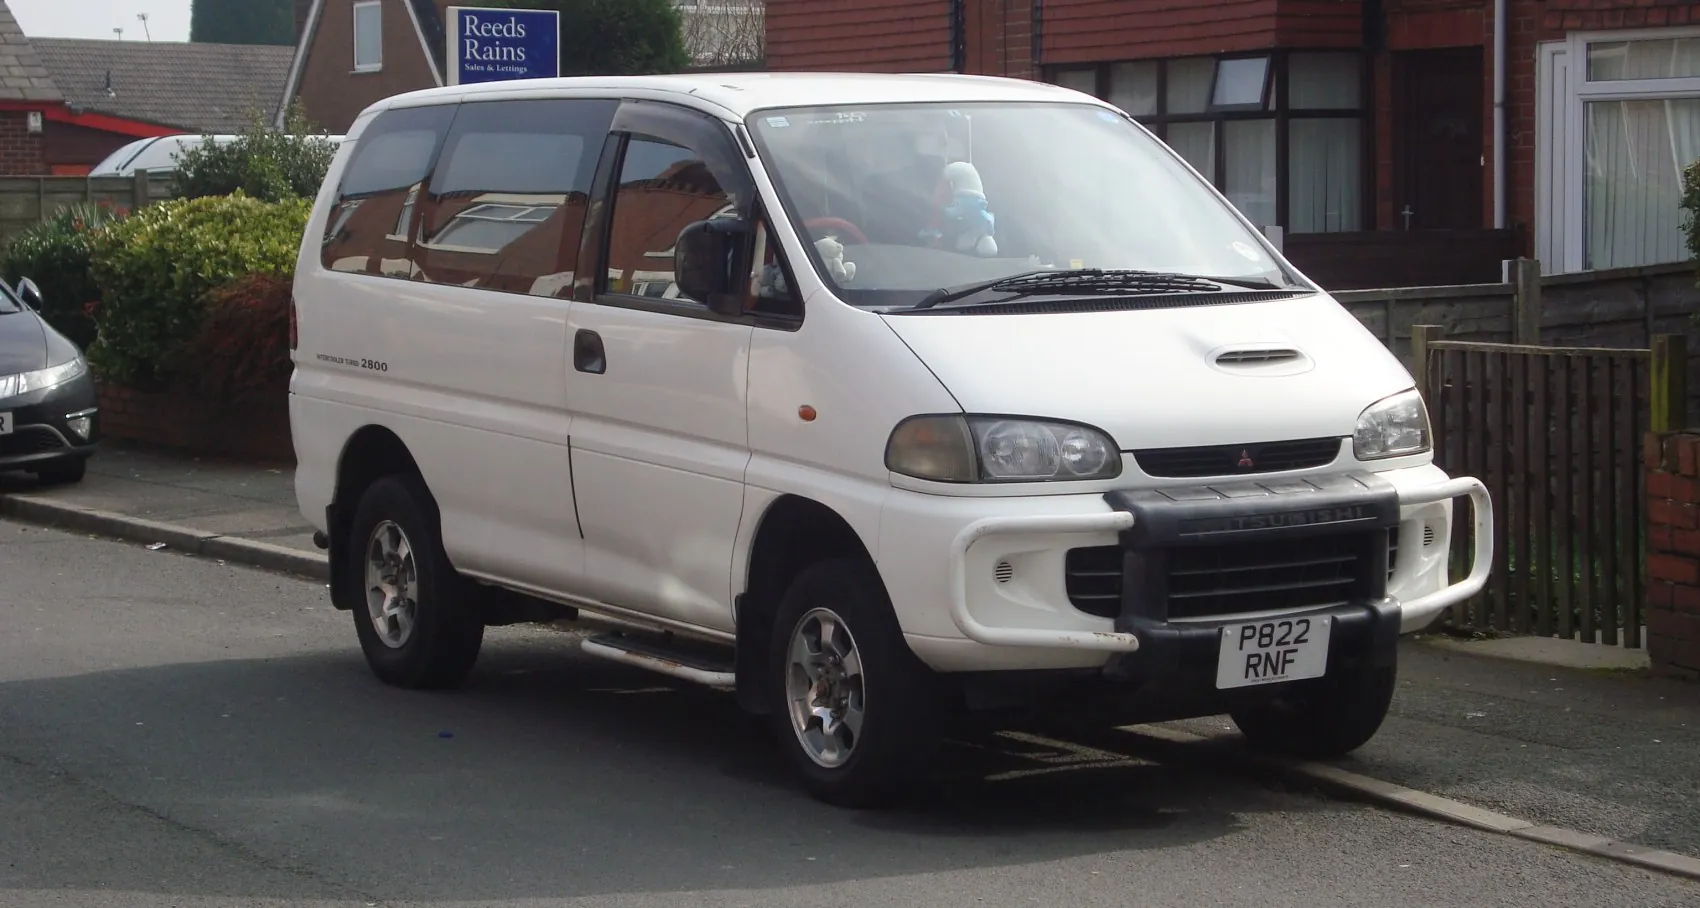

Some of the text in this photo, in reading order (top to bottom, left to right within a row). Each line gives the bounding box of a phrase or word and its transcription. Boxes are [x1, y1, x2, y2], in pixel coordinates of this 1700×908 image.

[464, 15, 526, 38] Reeds
[464, 39, 526, 61] Rains
[464, 63, 528, 74] Sales & Lettings
[361, 358, 388, 372] 2800
[1239, 619, 1311, 651] P822
[1244, 648, 1298, 679] RNF
